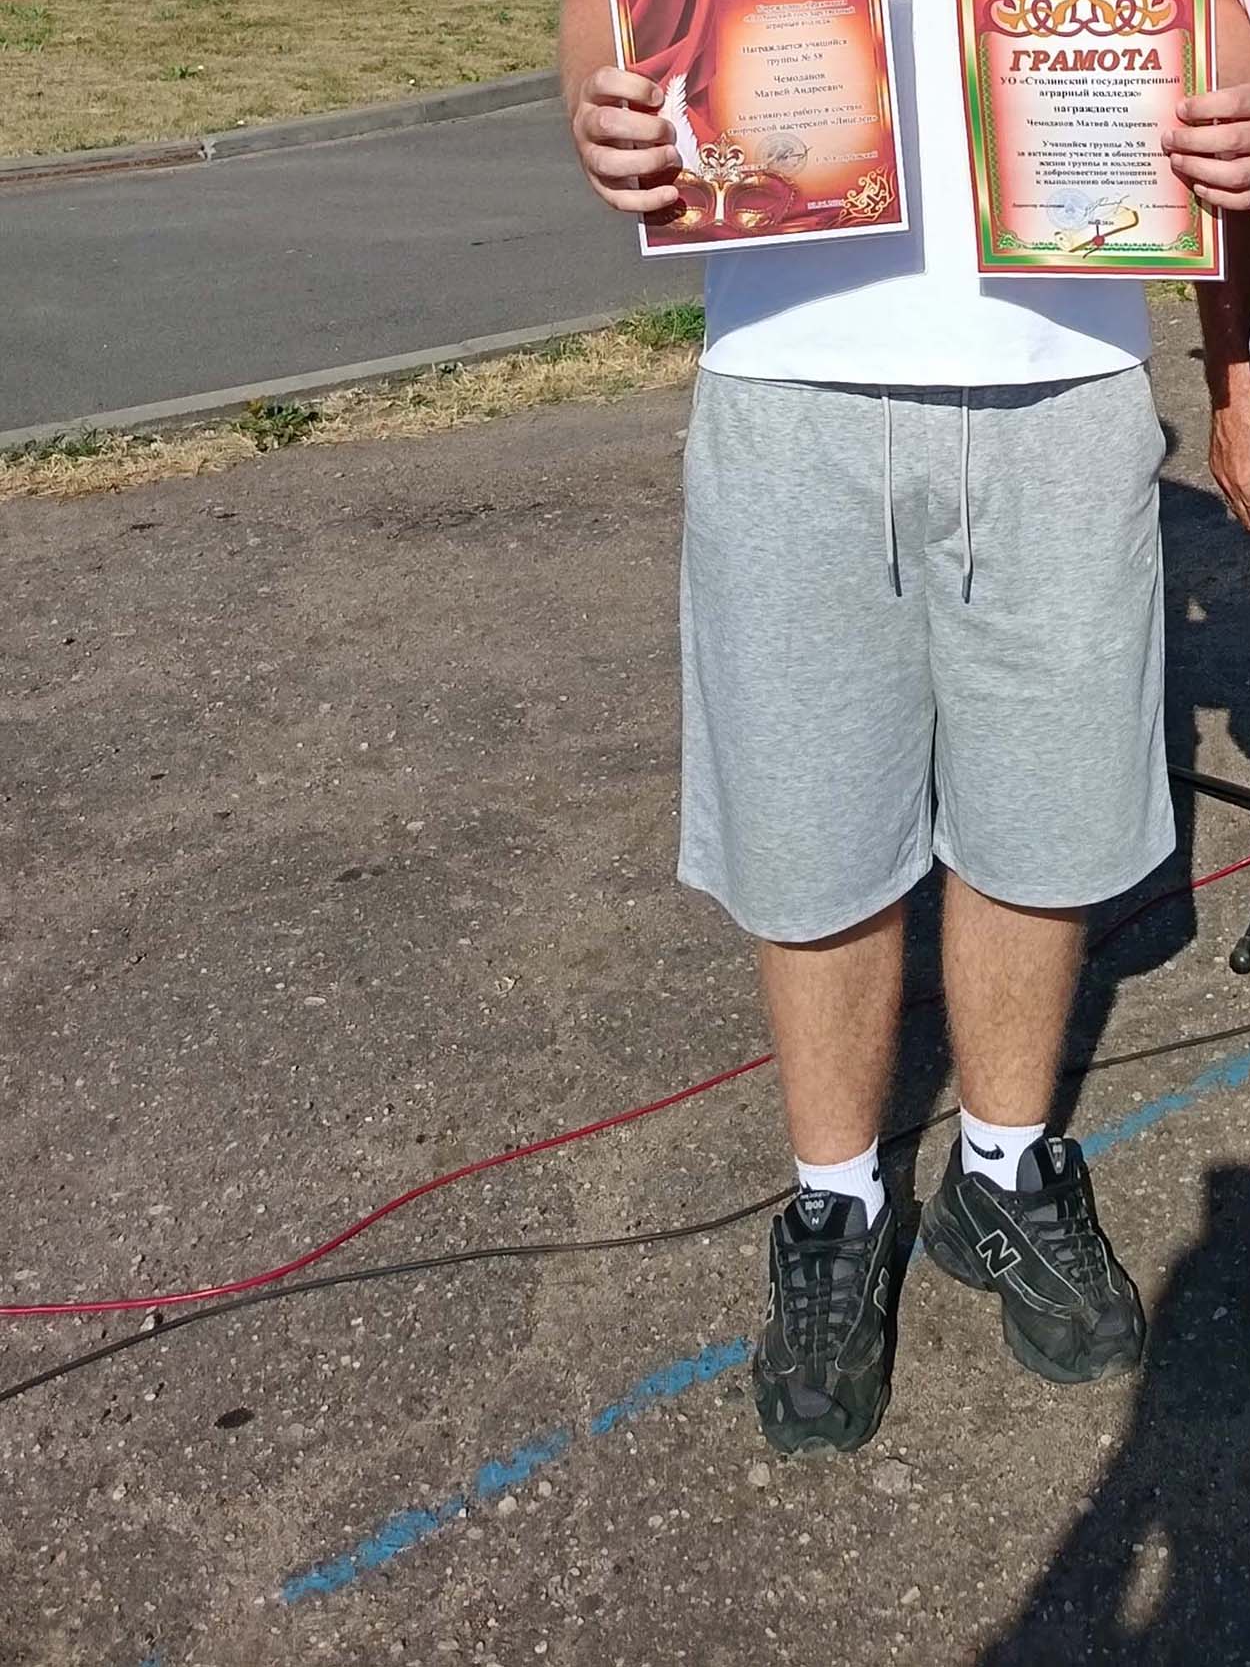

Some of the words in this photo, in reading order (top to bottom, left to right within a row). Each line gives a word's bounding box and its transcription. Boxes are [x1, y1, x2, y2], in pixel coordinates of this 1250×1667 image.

[1009, 48, 1163, 72] ГРАМОТА
[1000, 76, 1017, 85] УО
[1019, 76, 1088, 86] «Столинский
[1090, 76, 1181, 88] государственный
[754, 87, 790, 98] Матвей
[1039, 88, 1090, 99] аграрный
[1092, 89, 1142, 99] колледж»
[1053, 105, 1129, 115] награждается
[1076, 119, 1109, 127] Матвей
[1111, 120, 1158, 129] Андреевич
[1089, 140, 1122, 150] группы
[1068, 161, 1101, 169] группы
[976, 1229, 1022, 1278] N
